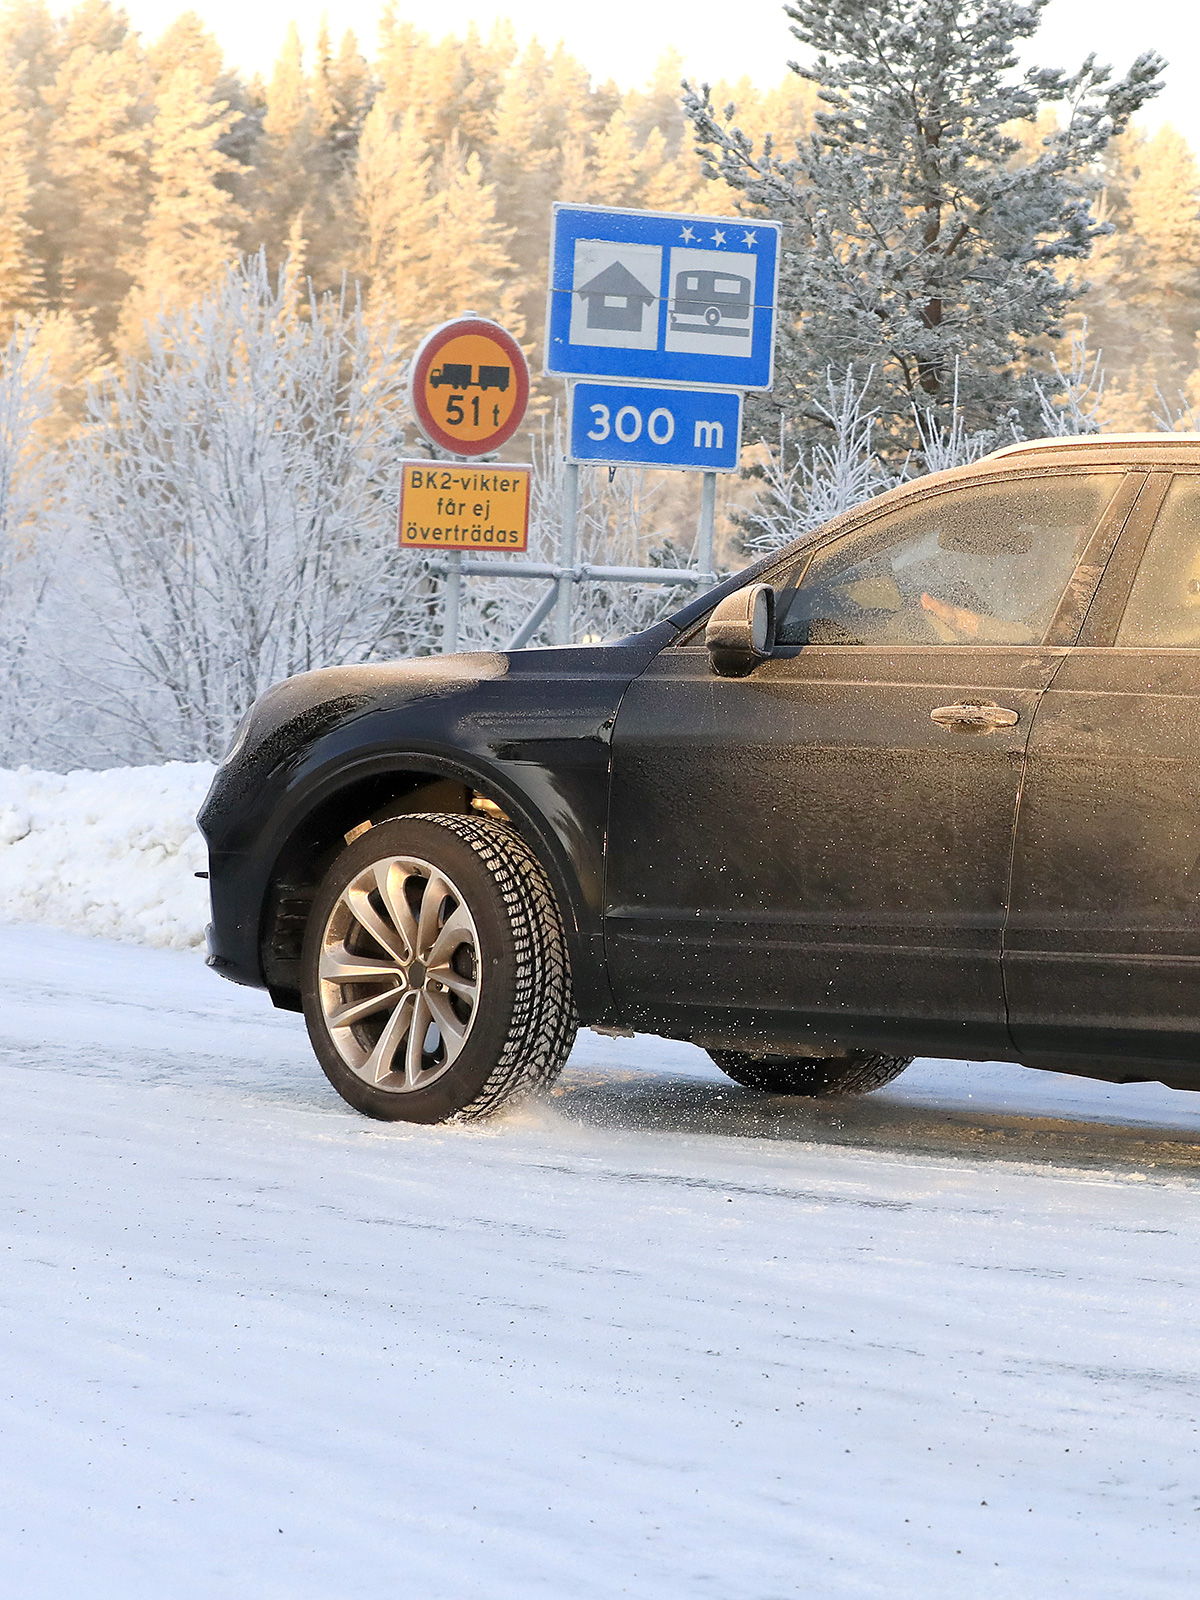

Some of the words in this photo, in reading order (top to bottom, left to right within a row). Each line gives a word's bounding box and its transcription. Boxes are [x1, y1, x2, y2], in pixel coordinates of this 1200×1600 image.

[446, 395, 480, 426] 51
[587, 403, 675, 445] 300
[693, 420, 724, 449] m
[411, 471, 519, 492] BK2-vikter
[437, 498, 466, 516] får
[473, 500, 490, 521] ej
[406, 522, 518, 543] överträdas
